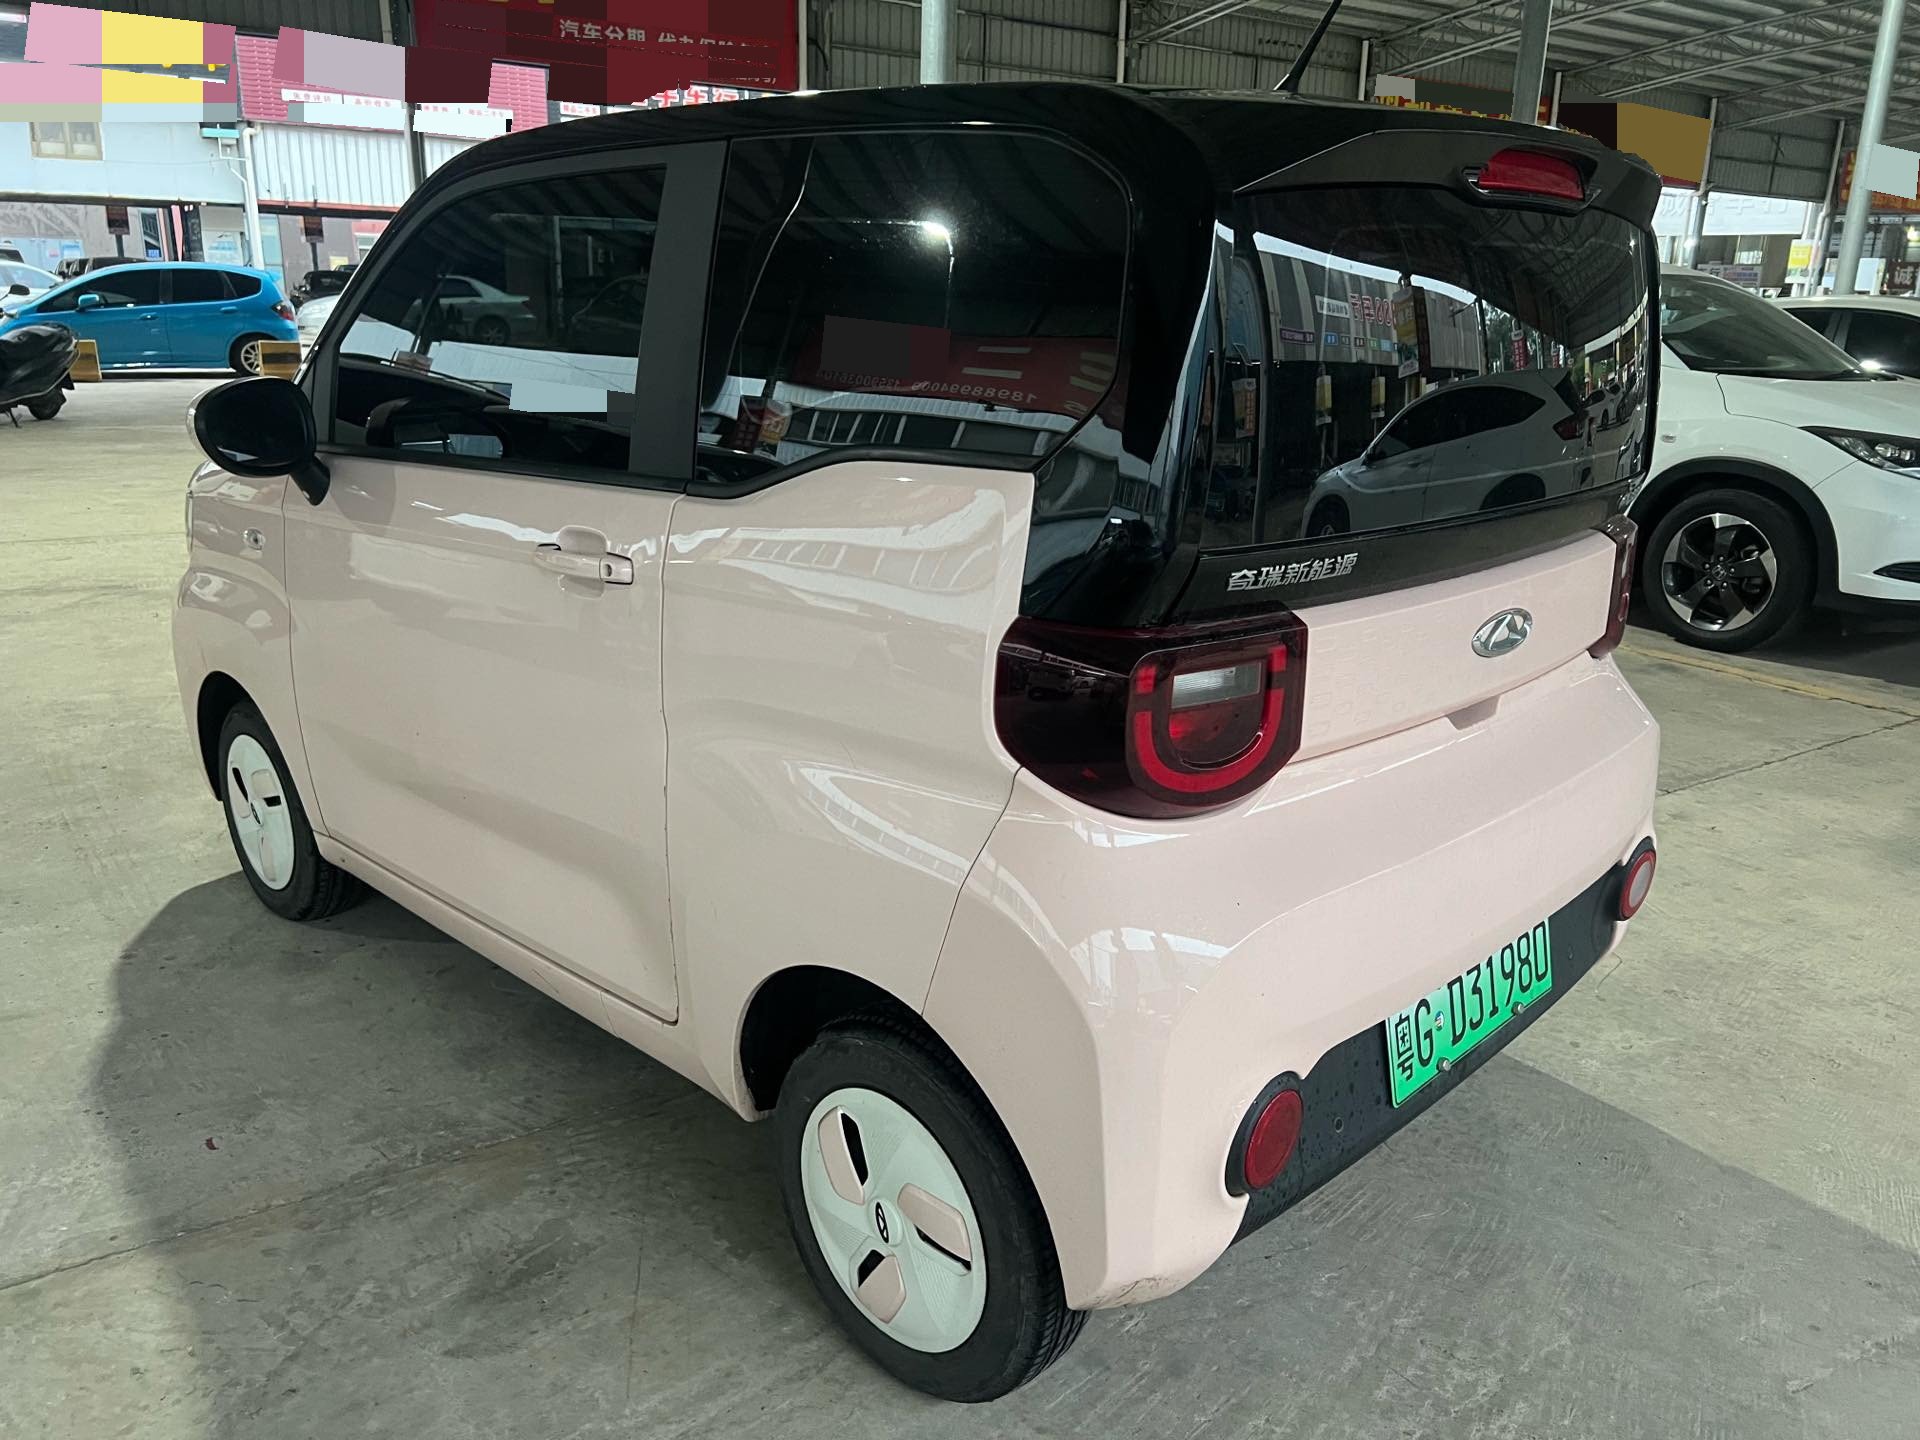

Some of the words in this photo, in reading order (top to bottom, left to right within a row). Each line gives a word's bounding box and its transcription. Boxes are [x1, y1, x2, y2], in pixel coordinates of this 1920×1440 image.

[560, 19, 646, 42] 汽车分期
[1226, 552, 1358, 591] 奇瑞新能源
